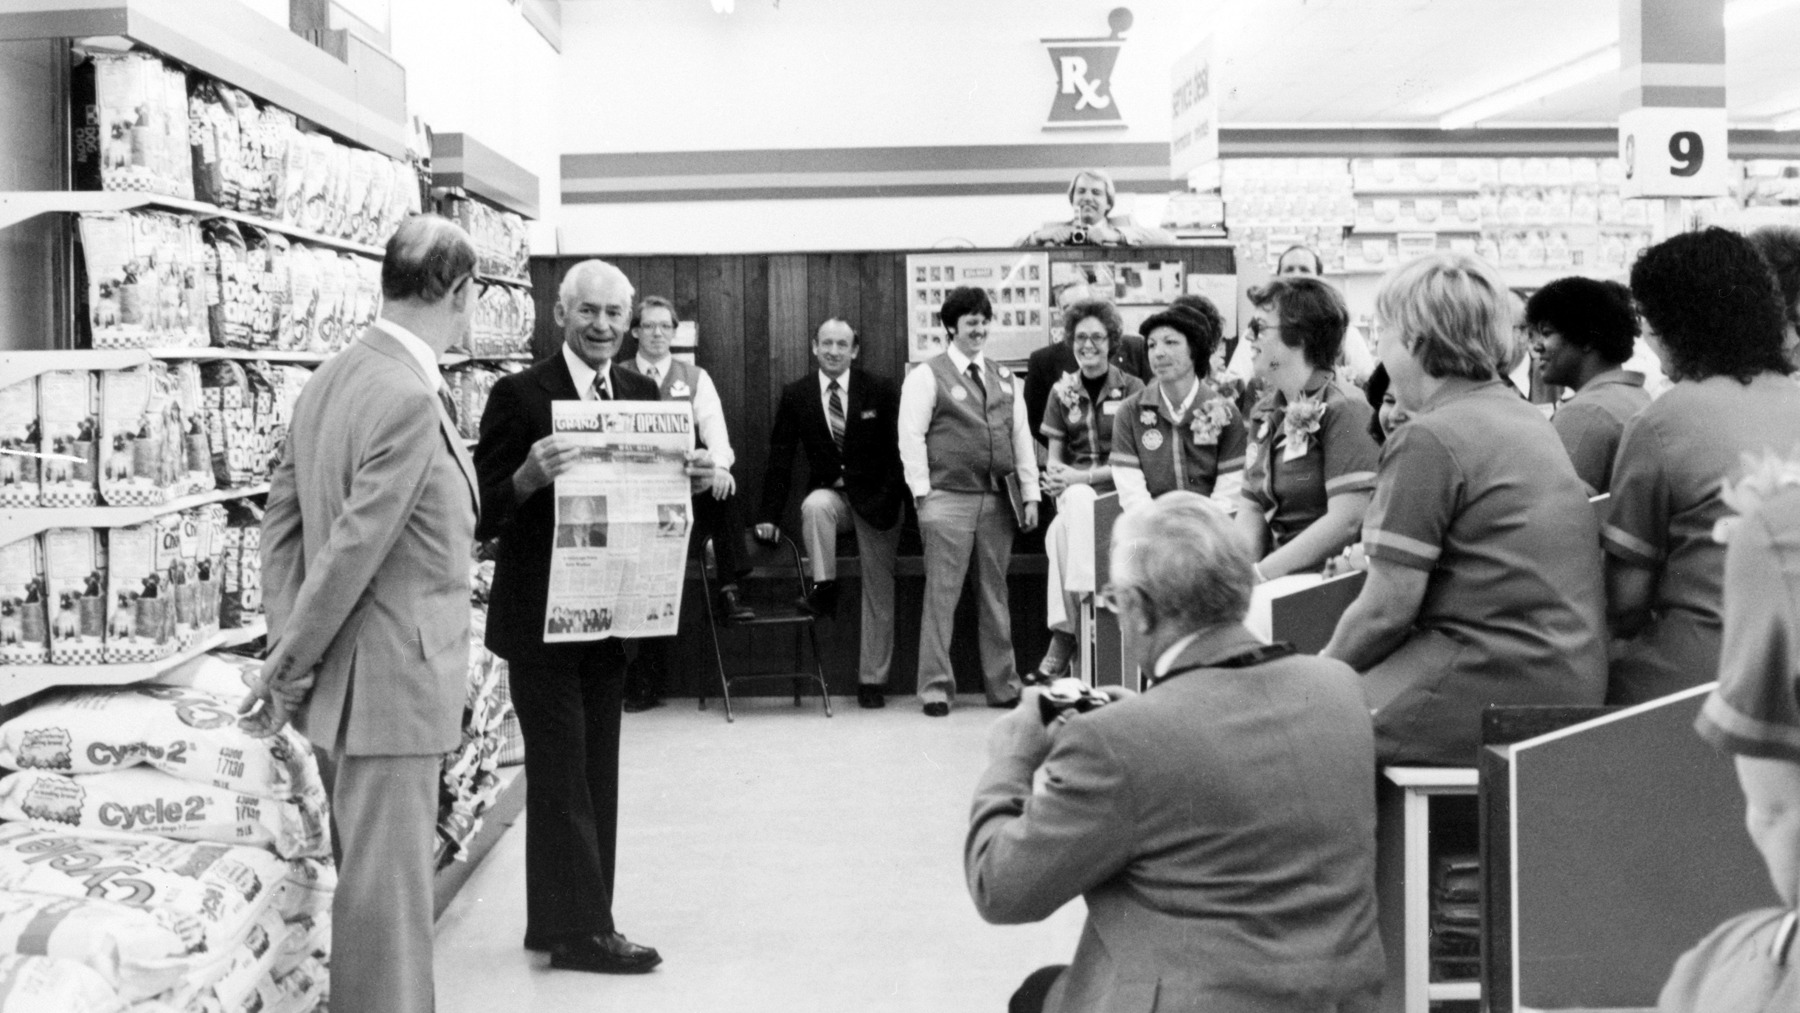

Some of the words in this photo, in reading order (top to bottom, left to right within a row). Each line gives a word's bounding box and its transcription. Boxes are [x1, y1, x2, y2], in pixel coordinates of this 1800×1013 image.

[1669, 131, 1705, 177] 9
[556, 416, 600, 431] GRAND
[636, 413, 689, 433] OPENING
